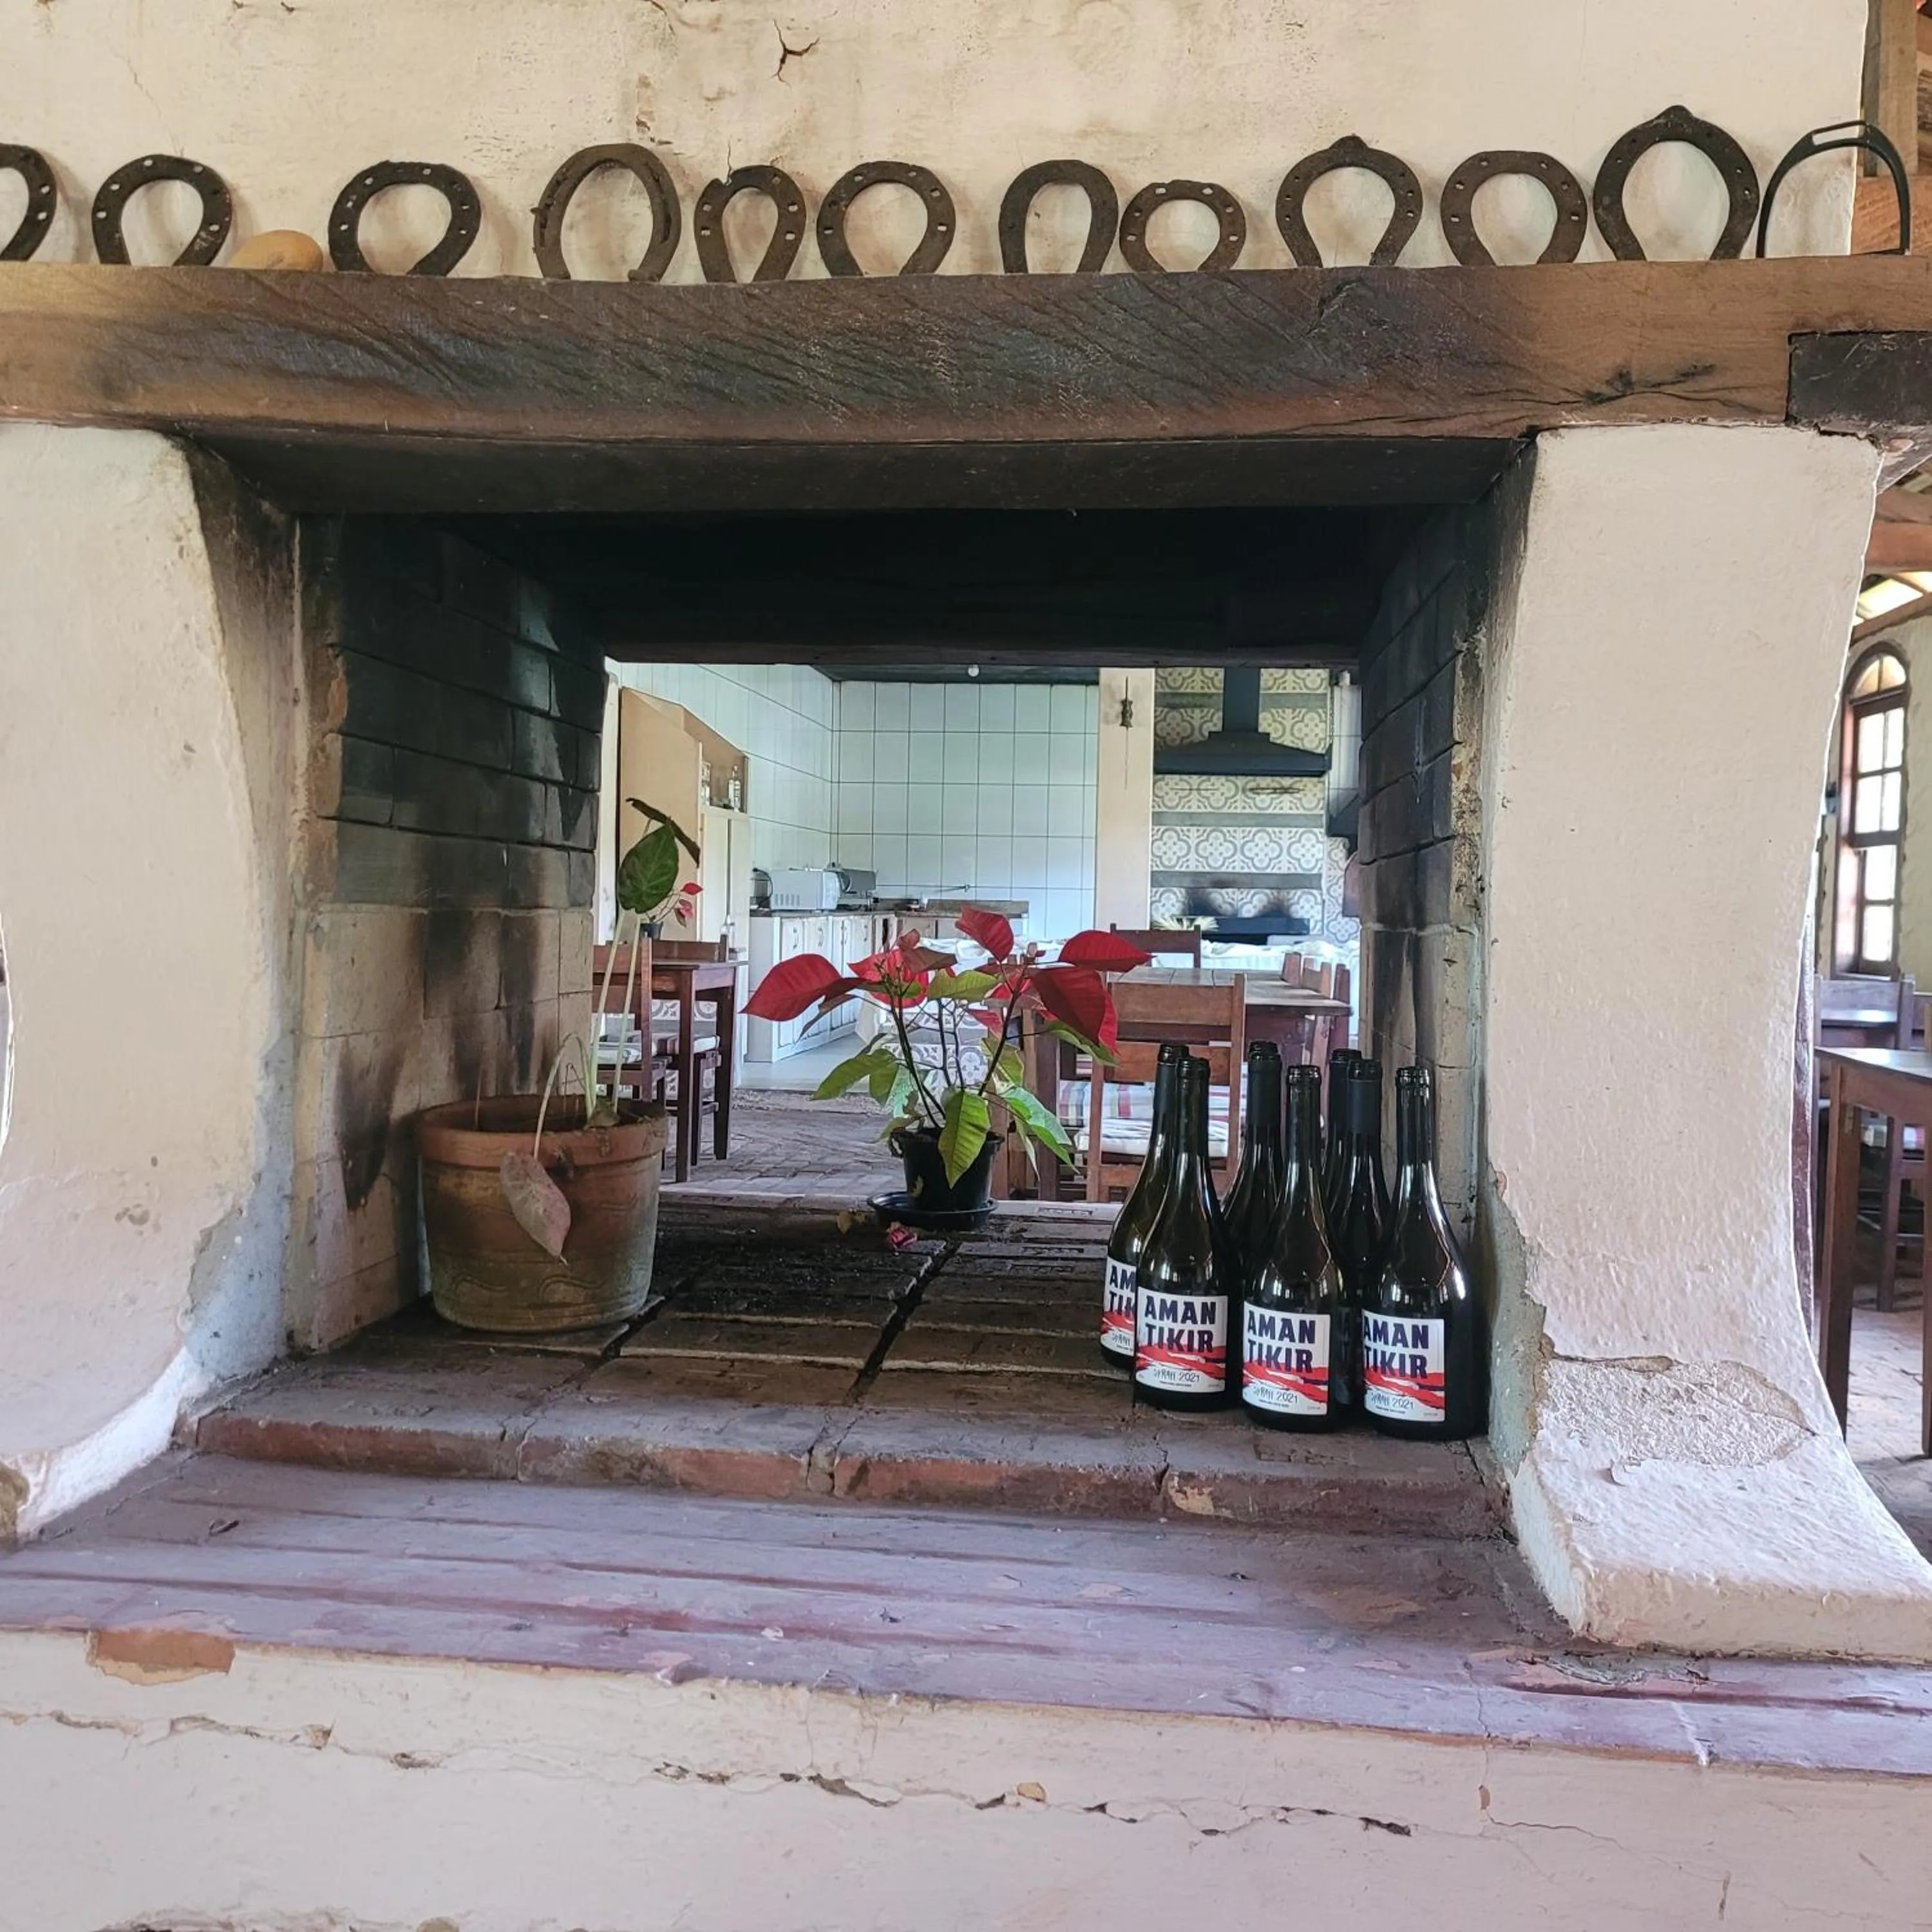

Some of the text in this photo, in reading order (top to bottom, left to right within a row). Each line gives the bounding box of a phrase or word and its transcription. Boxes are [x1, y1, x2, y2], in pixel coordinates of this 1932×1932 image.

[1110, 1265, 1135, 1292] AM
[1109, 1291, 1135, 1319] TIK
[1144, 1295, 1216, 1324] AMAN
[1145, 1323, 1214, 1352] TIKIR
[1247, 1310, 1315, 1343] AMAN
[1364, 1316, 1428, 1349] AMAN
[1247, 1338, 1313, 1373] TIKIR
[1365, 1345, 1428, 1379] TIKIR
[1179, 1372, 1200, 1383] 2021
[1277, 1392, 1298, 1404] 2021
[1392, 1397, 1414, 1410] 2021
